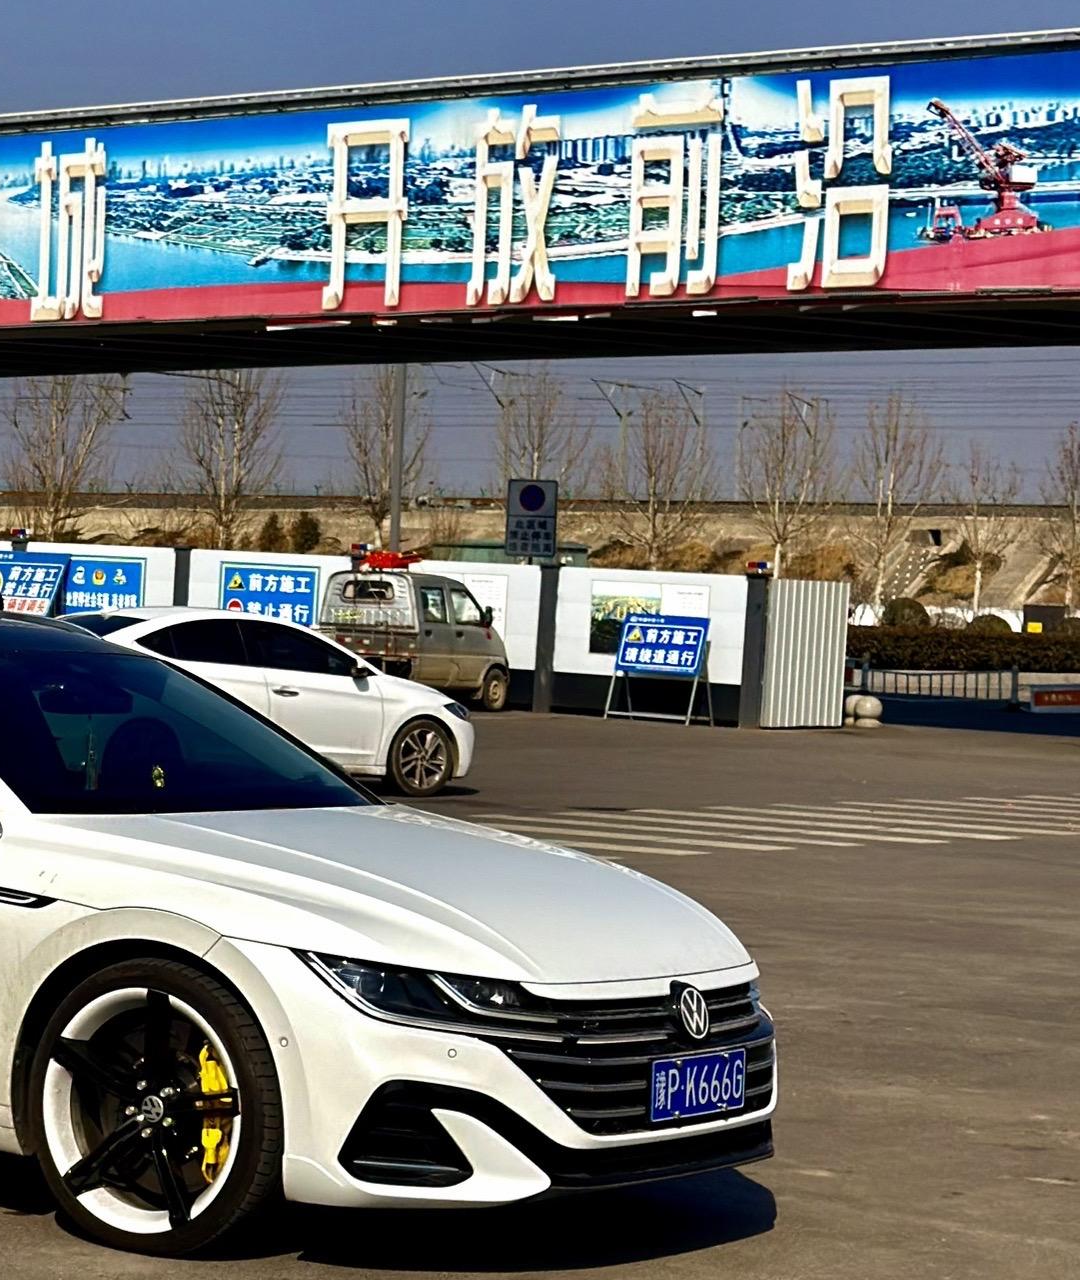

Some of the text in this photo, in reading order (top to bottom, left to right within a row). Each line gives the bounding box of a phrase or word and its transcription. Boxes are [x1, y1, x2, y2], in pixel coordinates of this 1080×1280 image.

[322, 76, 892, 309] 开放前沿
[8, 566, 58, 583] 前方施工
[248, 573, 311, 593] 前方施工
[3, 582, 53, 599] 禁止通行
[246, 601, 309, 623] 禁止通行
[645, 628, 698, 645] 前方施工
[625, 647, 694, 666] 请绕道通行
